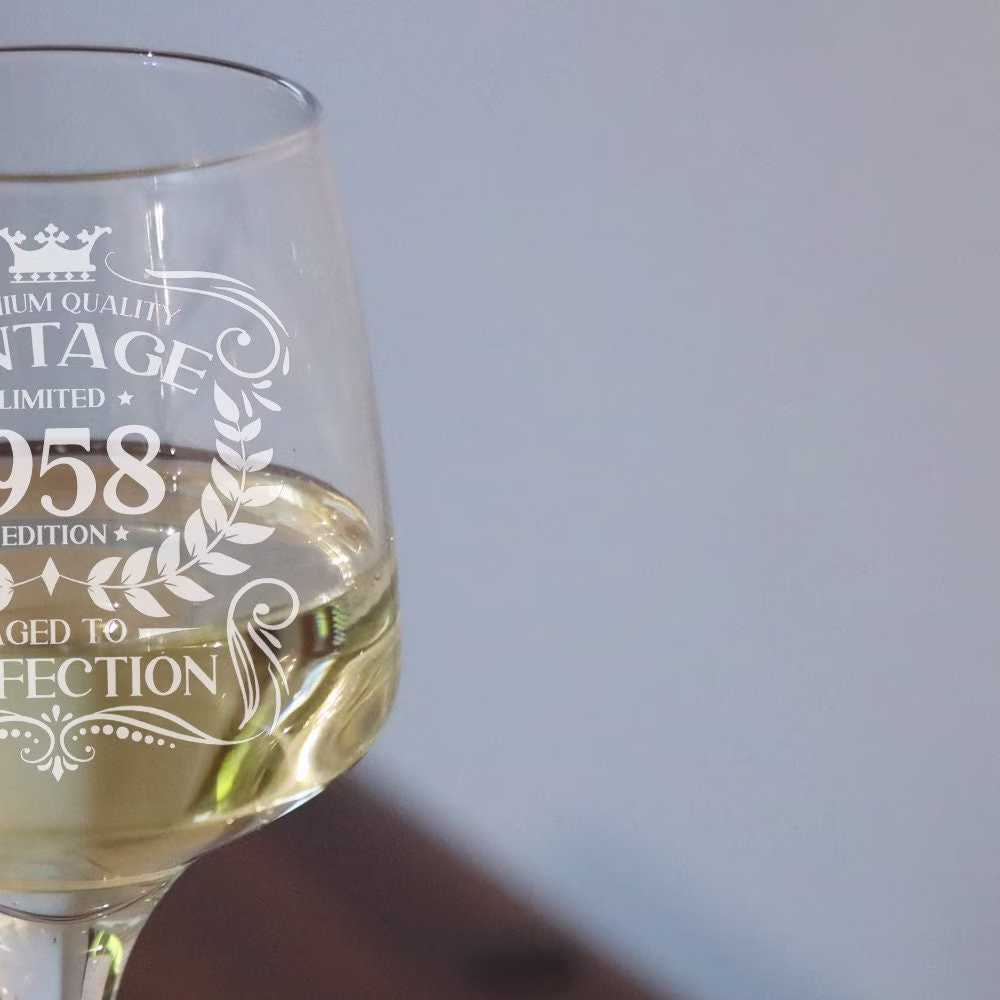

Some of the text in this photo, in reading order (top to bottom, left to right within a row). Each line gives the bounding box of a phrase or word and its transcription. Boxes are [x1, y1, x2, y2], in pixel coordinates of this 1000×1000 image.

[61, 292, 183, 327] QUALITY
[1, 524, 108, 547] EDITION
[82, 618, 128, 644] TO
